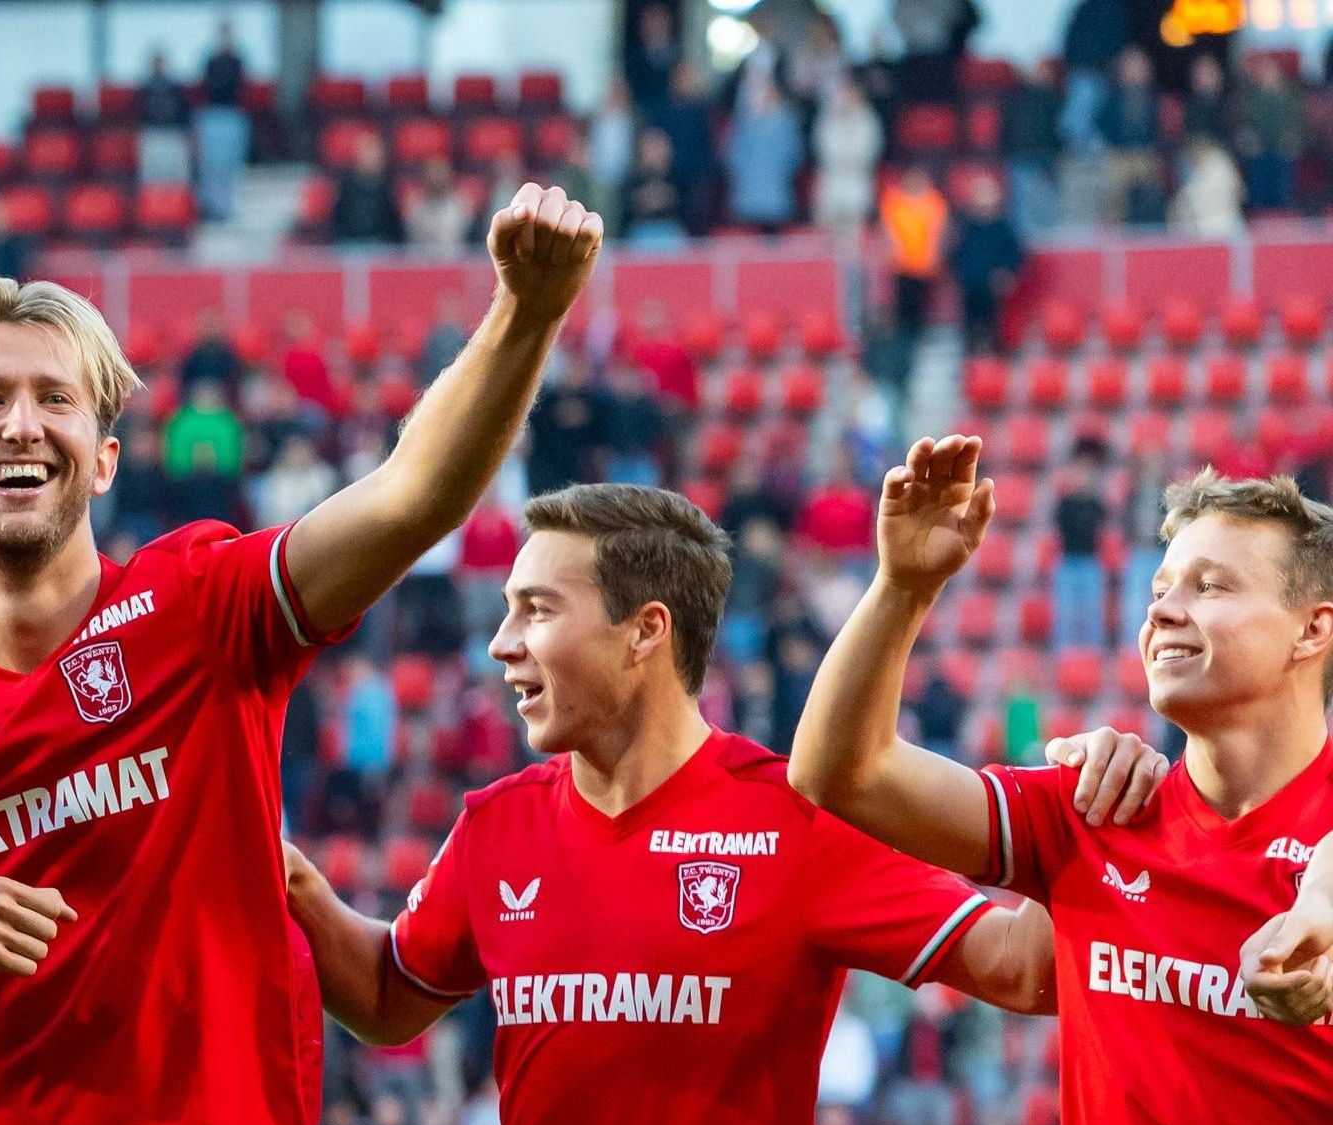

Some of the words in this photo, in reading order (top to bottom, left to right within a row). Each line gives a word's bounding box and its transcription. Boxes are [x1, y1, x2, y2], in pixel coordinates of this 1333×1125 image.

[73, 589, 155, 645] RAMAT
[80, 646, 117, 663] TWENTE
[649, 830, 780, 855] ELEKTRAMAT
[1089, 941, 1264, 1019] ELEKTRA
